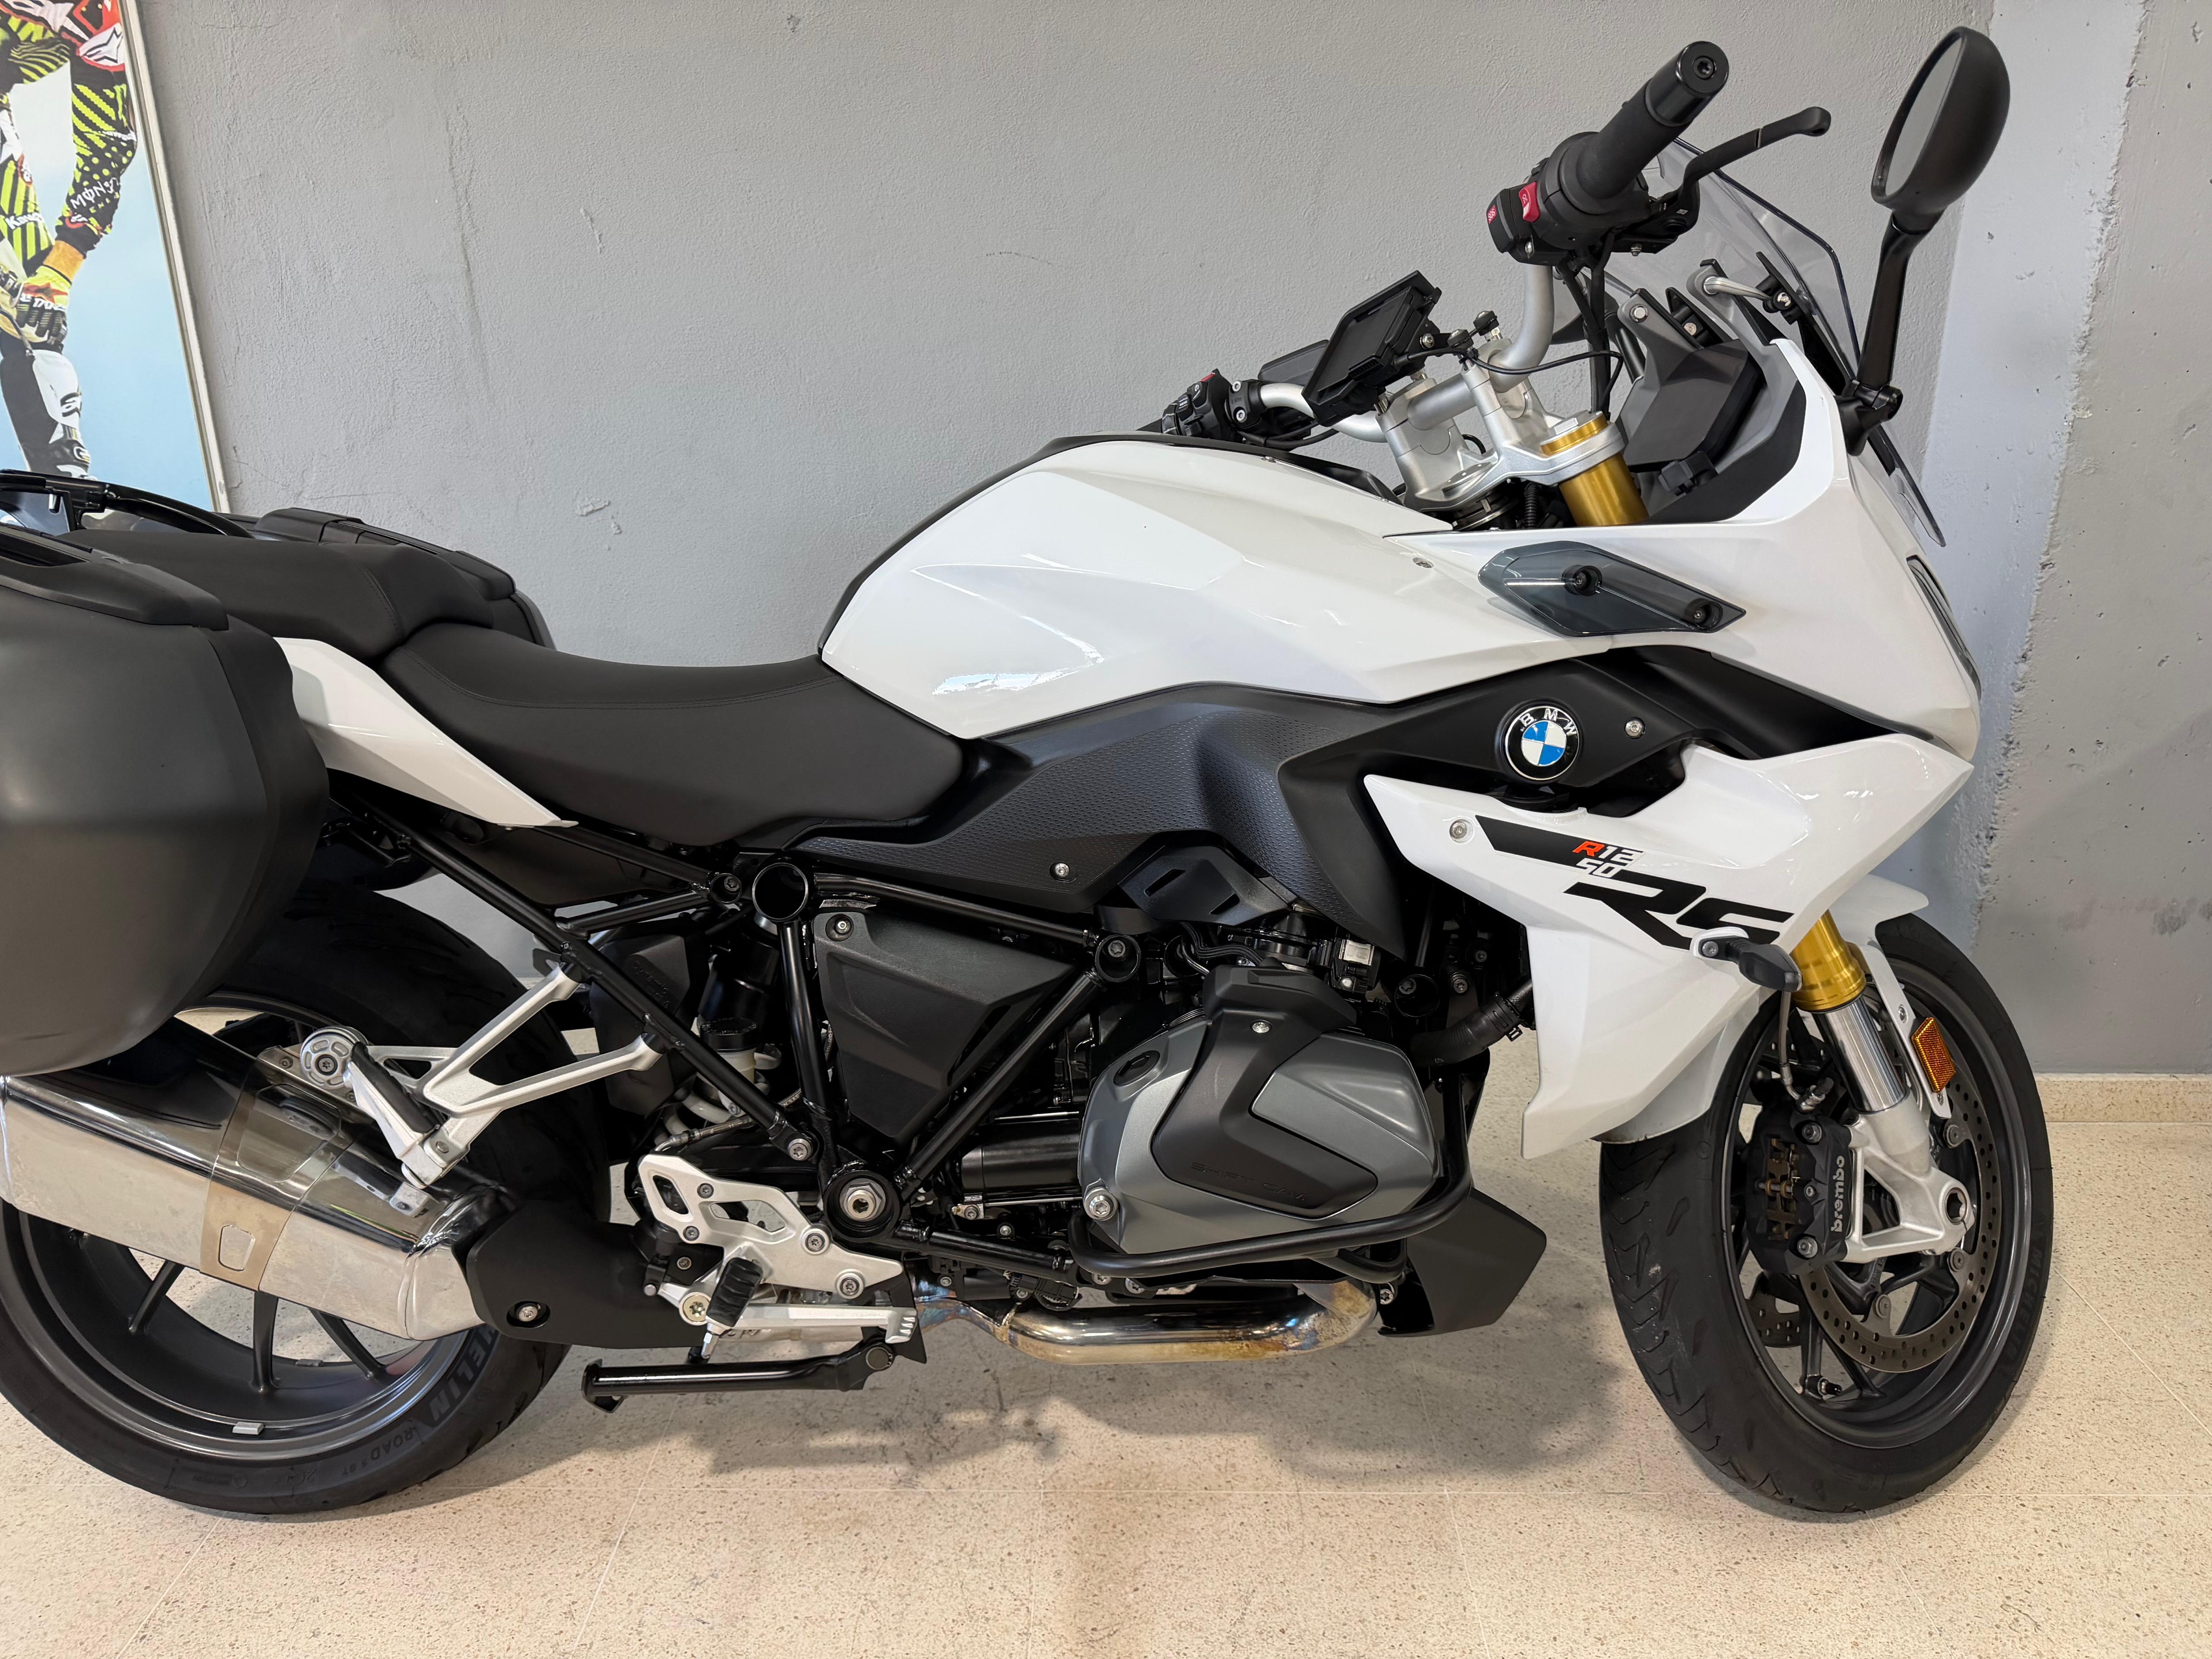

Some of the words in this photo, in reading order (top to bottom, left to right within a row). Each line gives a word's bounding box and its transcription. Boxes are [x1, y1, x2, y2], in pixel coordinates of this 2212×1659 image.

[1519, 708, 1577, 736] BMW
[1563, 868, 1796, 951] RS
[1830, 1155, 1845, 1232] brembo
[370, 1425, 416, 1460] ROAD
